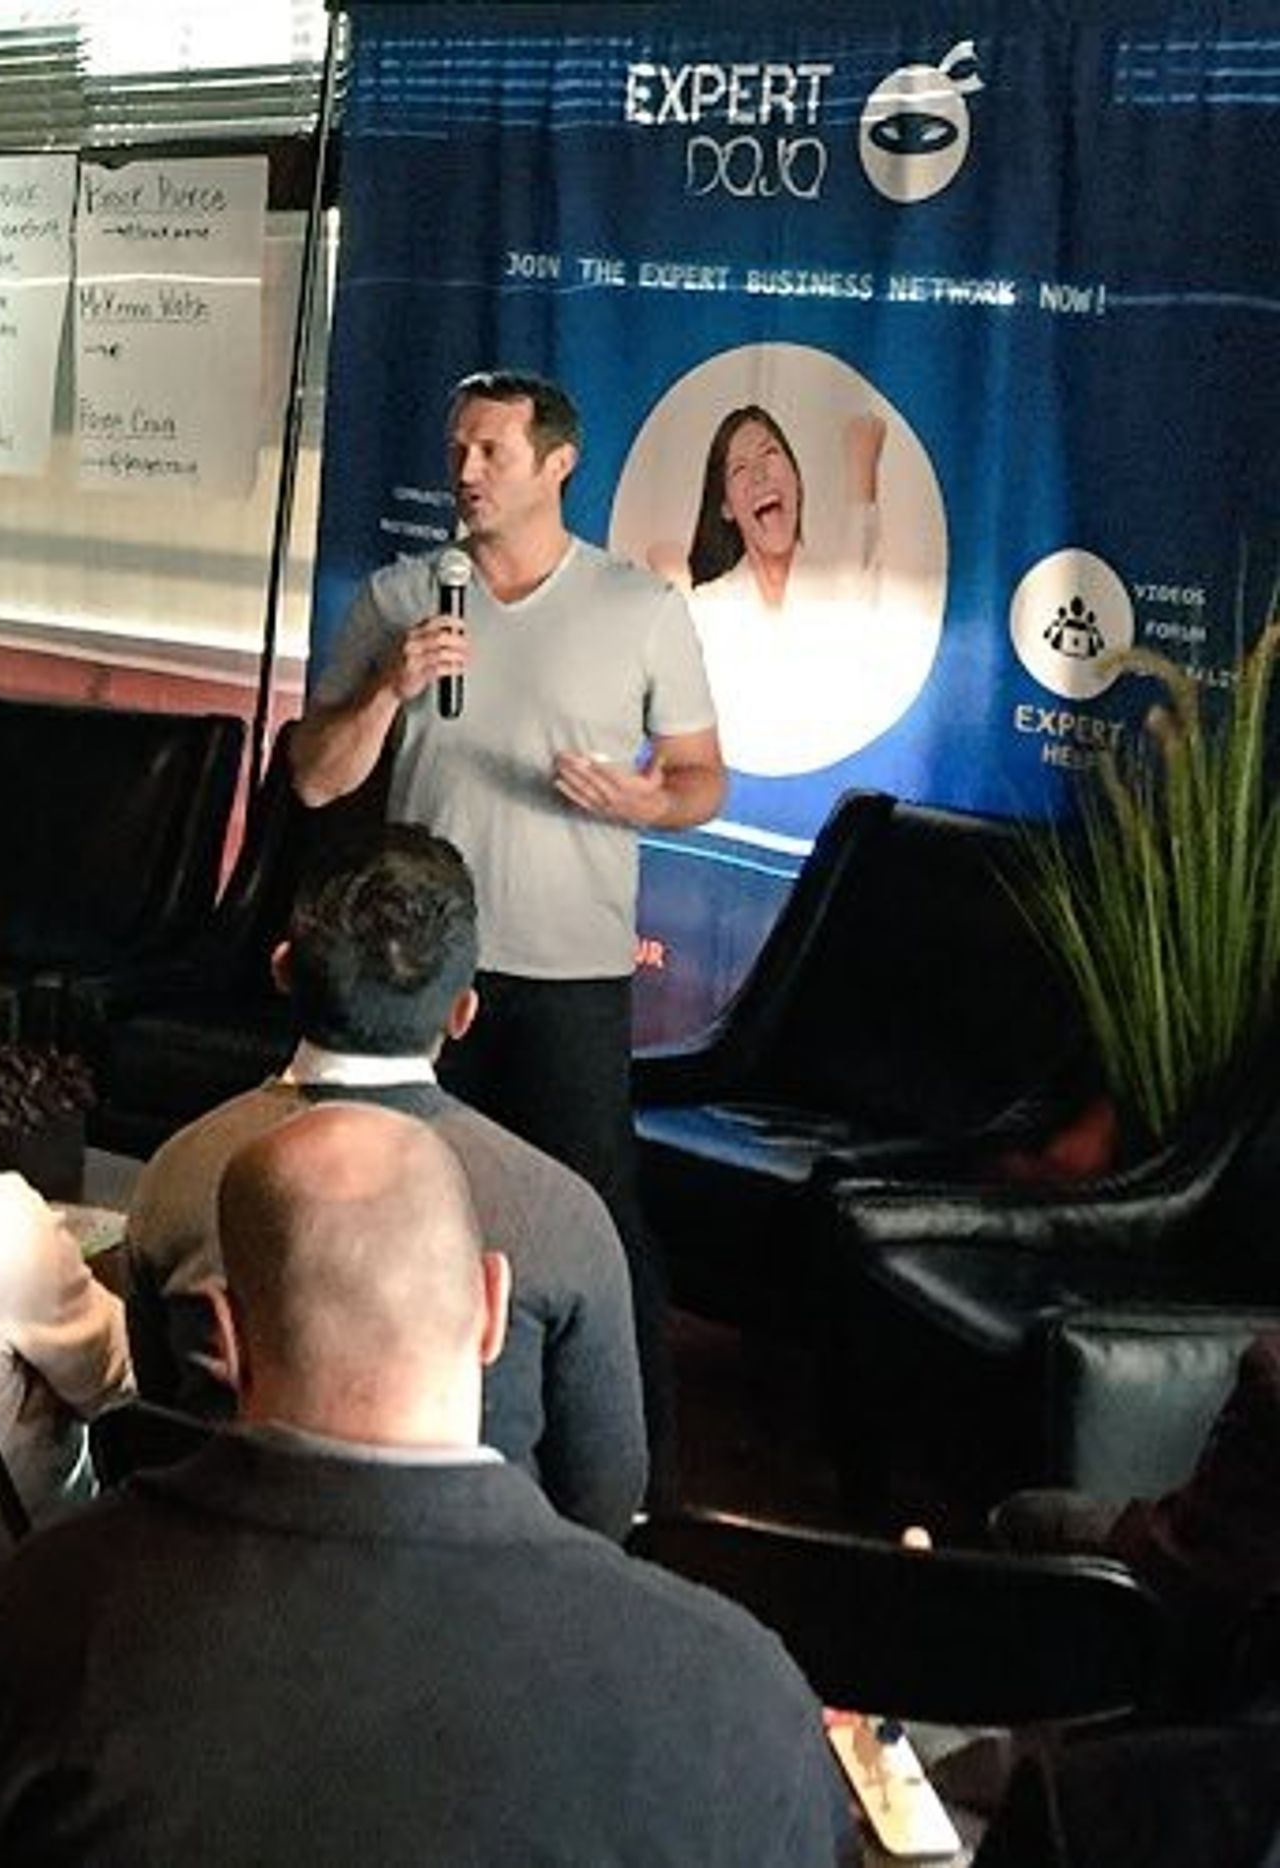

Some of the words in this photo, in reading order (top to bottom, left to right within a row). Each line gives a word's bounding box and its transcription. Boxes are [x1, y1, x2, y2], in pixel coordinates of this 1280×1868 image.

[623, 63, 834, 126] EXPERT
[686, 134, 827, 198] DOJO
[505, 251, 561, 279] JOIN
[578, 258, 626, 286] THE
[639, 262, 730, 291] EXPERT
[746, 269, 873, 300] BUSINESS
[889, 277, 1016, 306] NETWORK
[1040, 283, 1107, 315] NOW!
[1133, 584, 1206, 605] VIDEOS
[1144, 621, 1207, 642] FORUM
[1013, 704, 1124, 747] EXPERT
